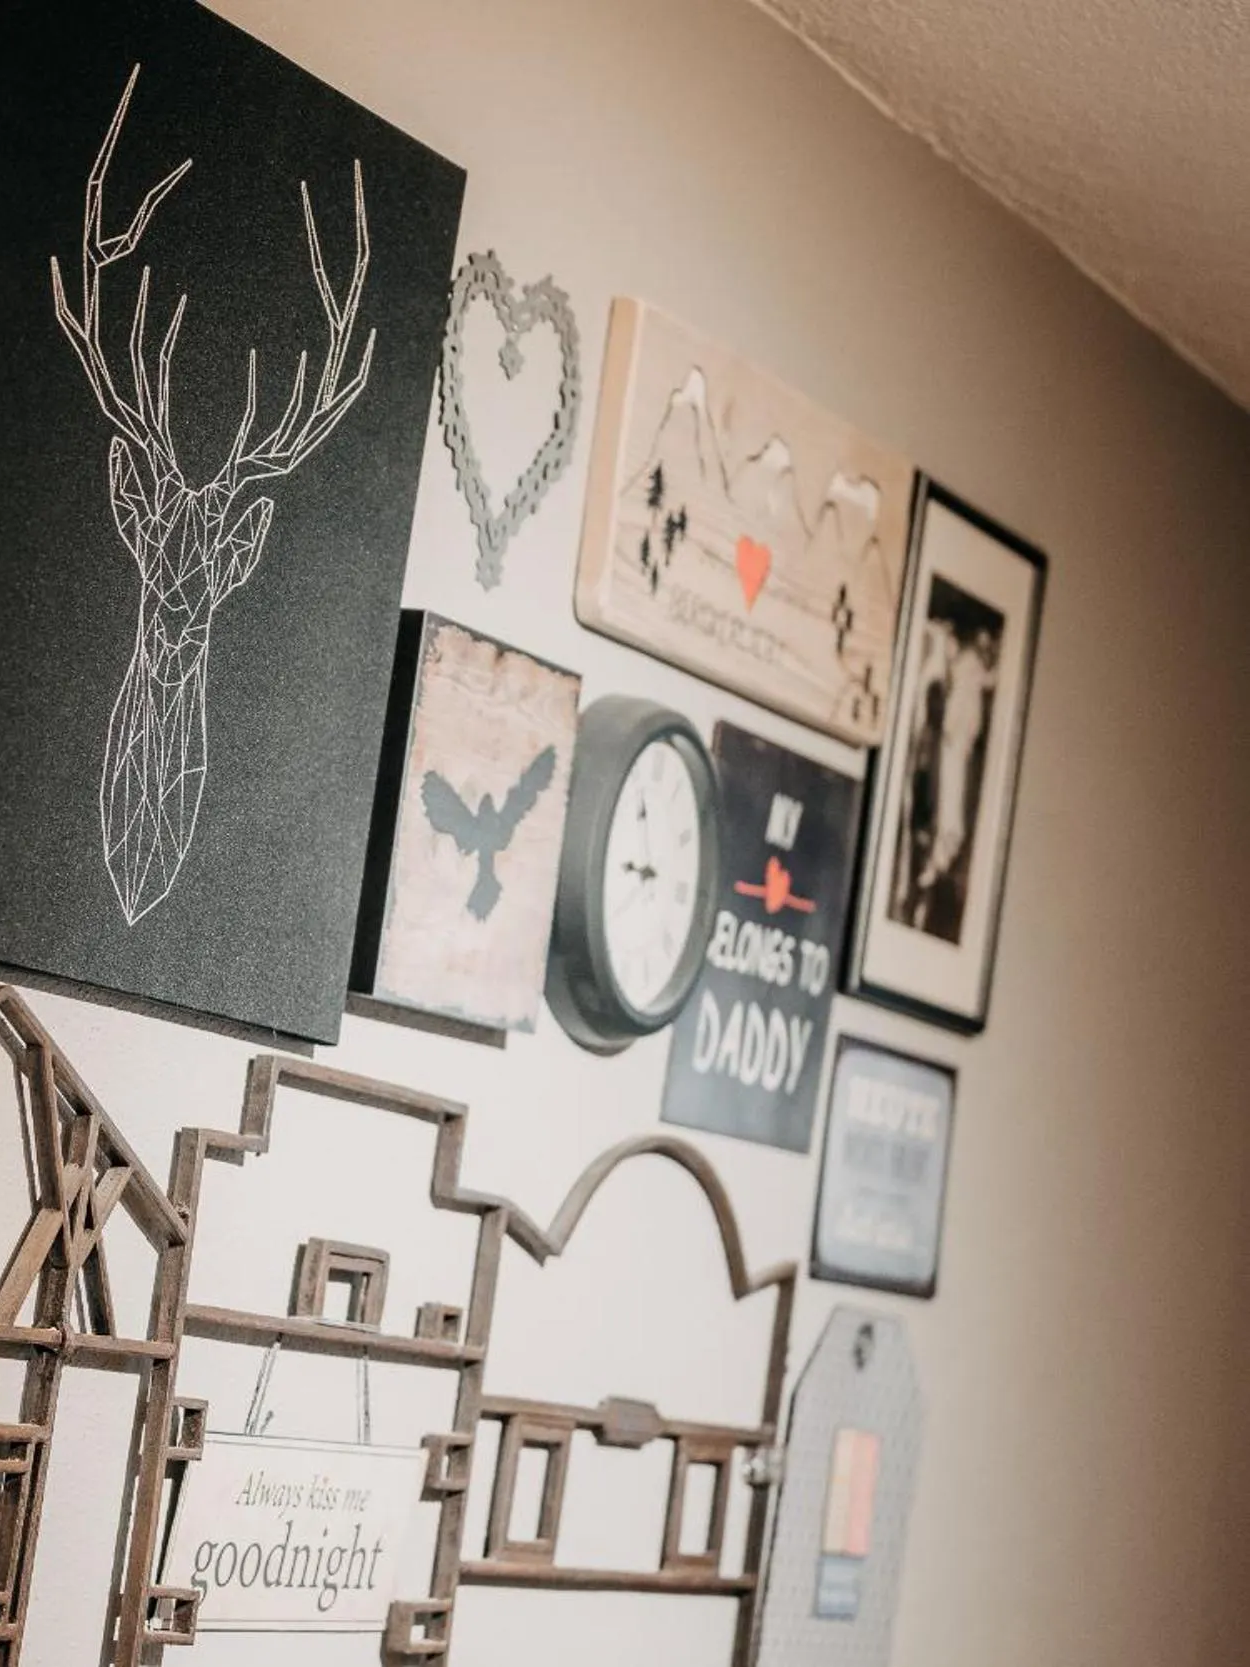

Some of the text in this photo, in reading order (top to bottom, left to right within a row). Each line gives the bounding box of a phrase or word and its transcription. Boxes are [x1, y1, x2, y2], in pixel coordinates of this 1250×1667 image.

[798, 939, 830, 998] TO
[691, 988, 814, 1096] DADDY
[235, 1470, 372, 1519] Always kiss me
[190, 1519, 383, 1613] goodnight
